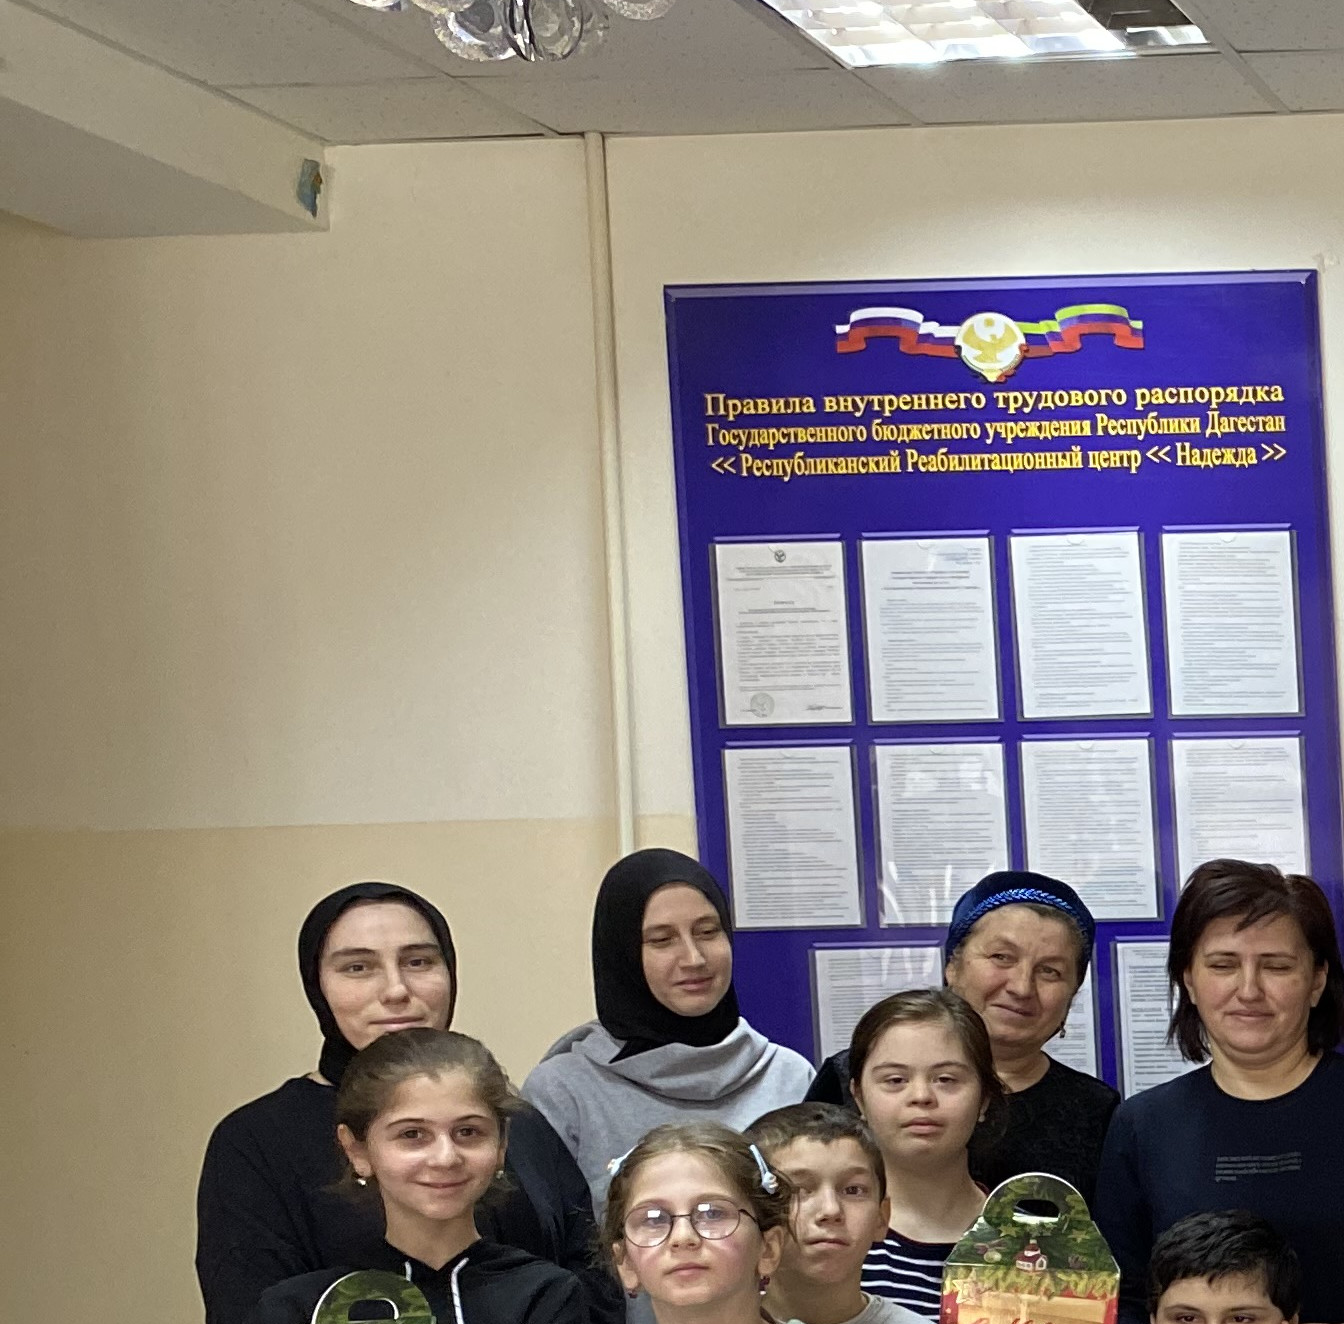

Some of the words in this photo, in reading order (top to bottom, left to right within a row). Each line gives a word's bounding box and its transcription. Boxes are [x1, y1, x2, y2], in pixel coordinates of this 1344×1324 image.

[705, 393, 816, 420] Правила
[824, 392, 986, 417] внутреннего
[994, 389, 1127, 413] трудового
[1135, 385, 1284, 409] распорядка
[706, 423, 867, 450] Государственного
[872, 419, 980, 443] бюджетного
[986, 420, 1091, 443] учреждения
[1095, 412, 1200, 440] Республики
[1205, 410, 1285, 437] Дагестан
[740, 450, 901, 482] Республиканский
[905, 446, 1083, 473] Реабилитационный
[1087, 450, 1141, 473] центр
[1176, 442, 1257, 468] Надежда
